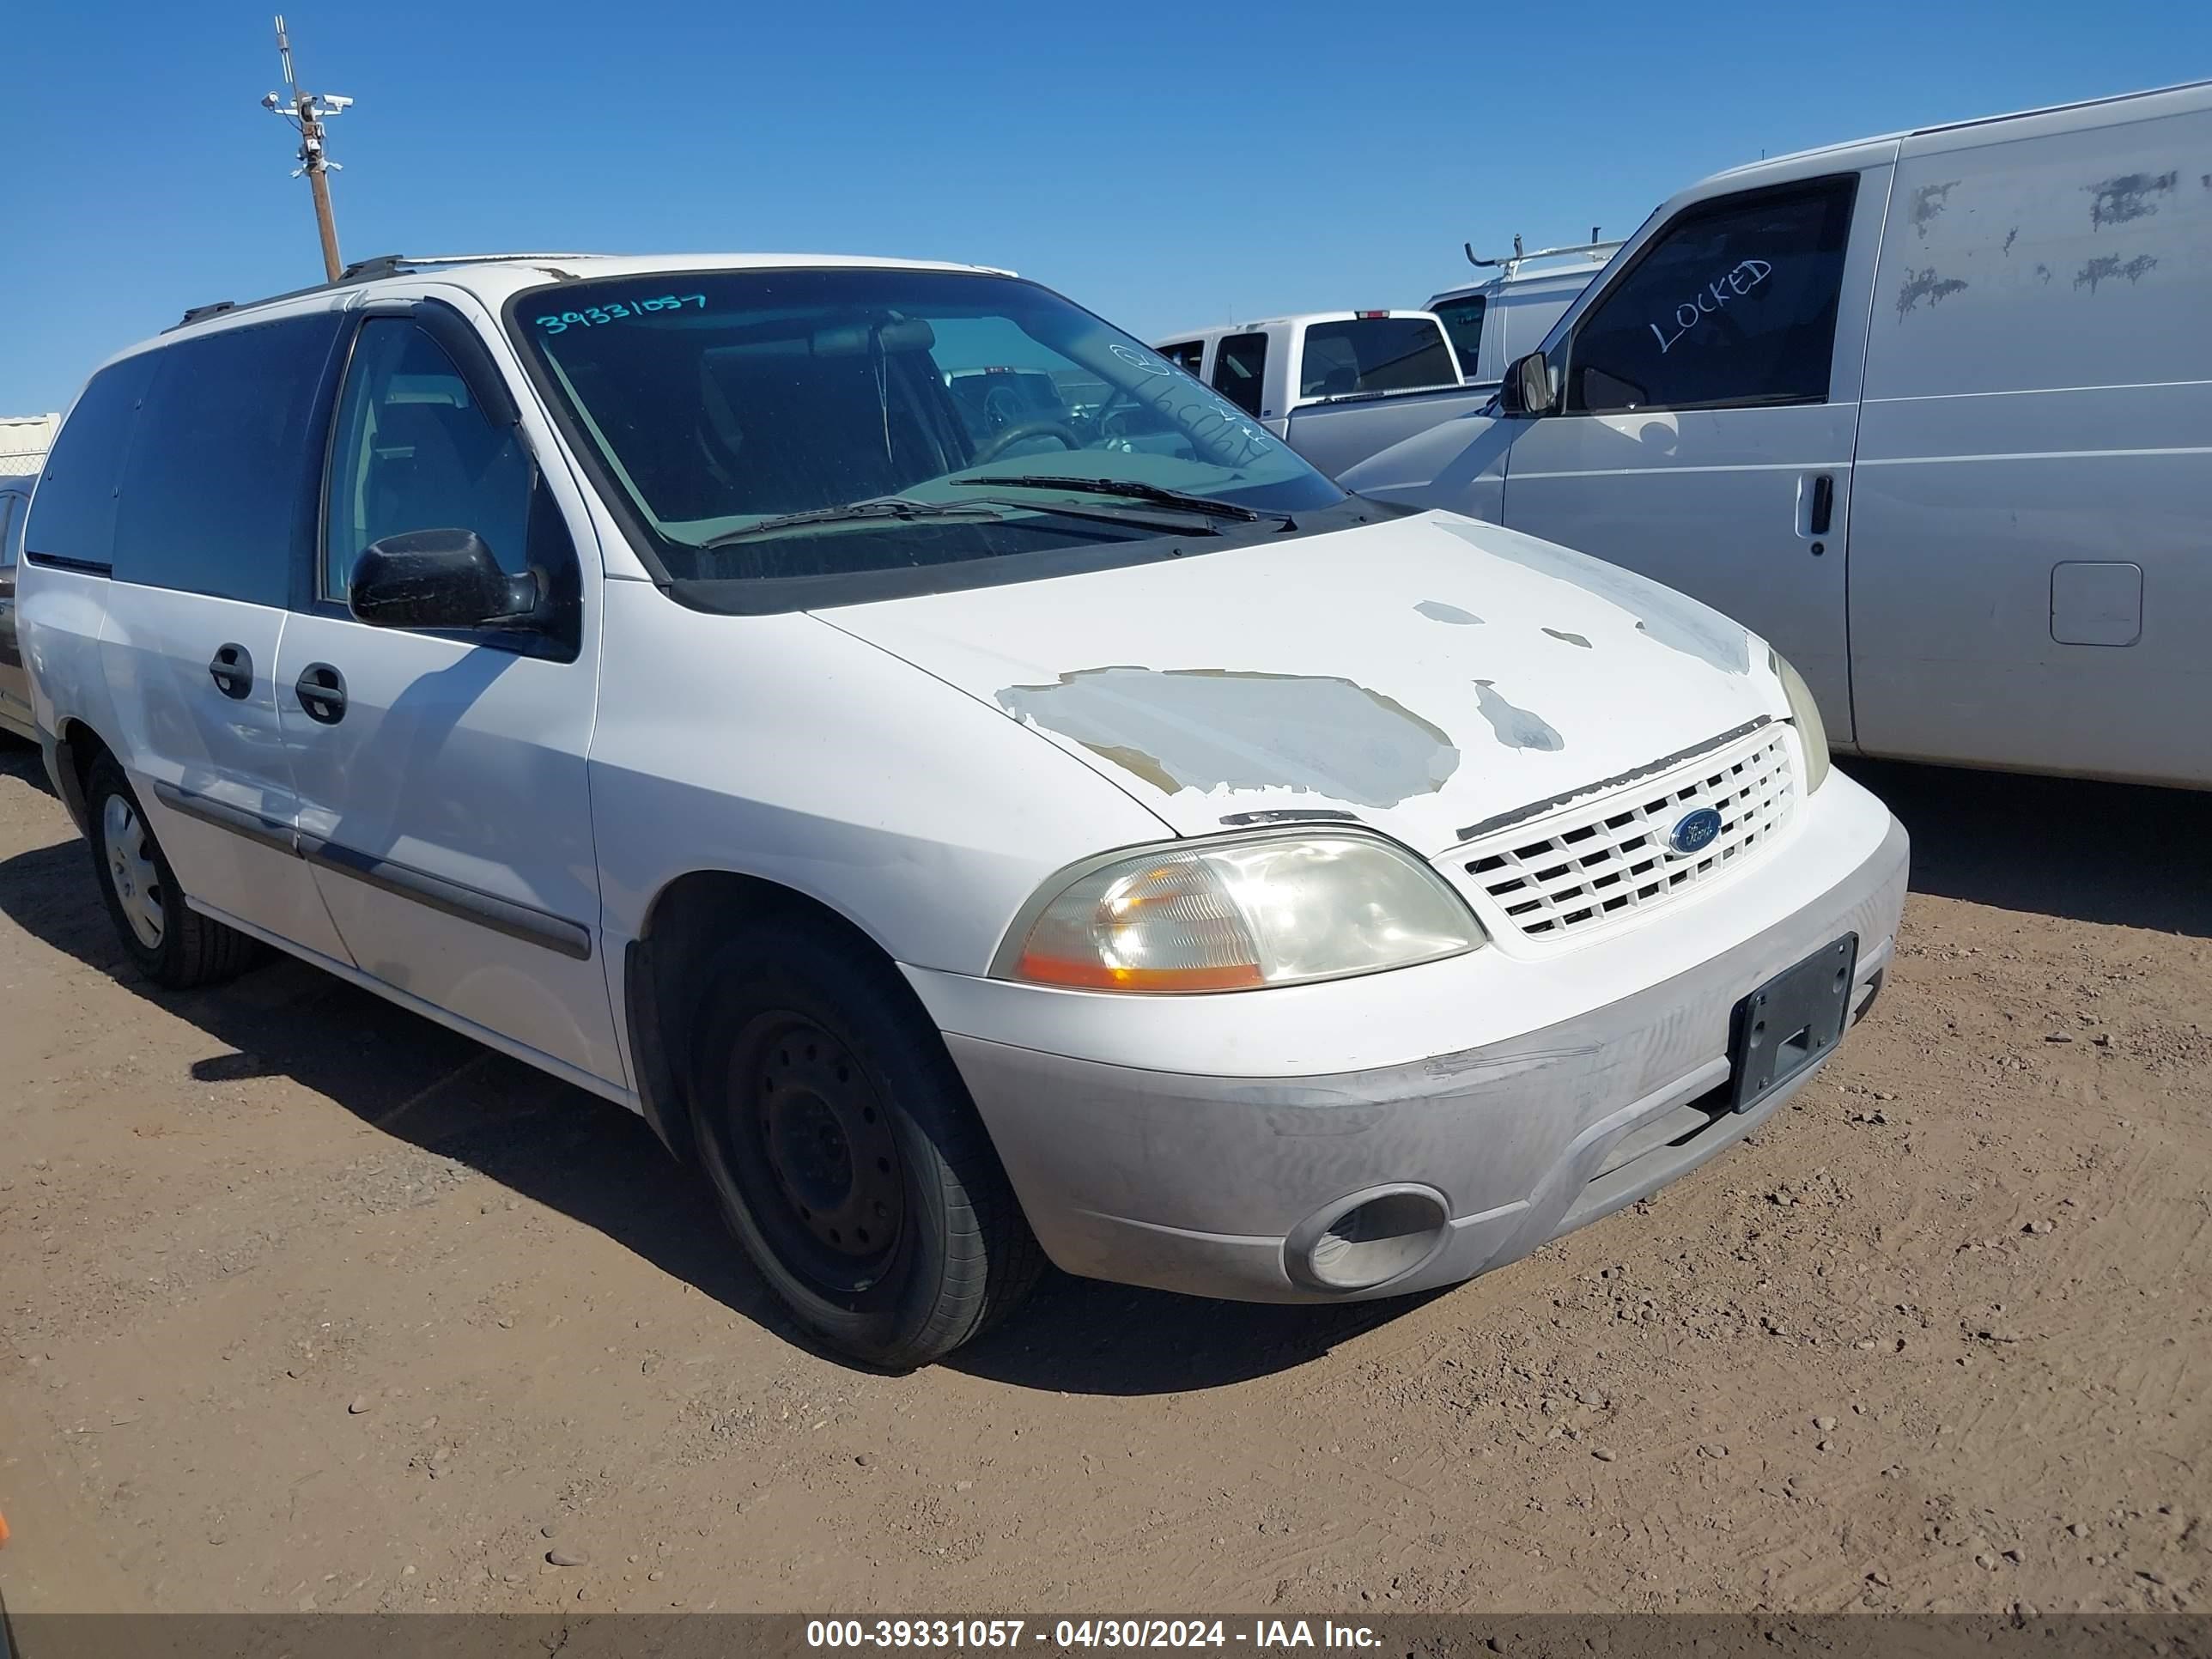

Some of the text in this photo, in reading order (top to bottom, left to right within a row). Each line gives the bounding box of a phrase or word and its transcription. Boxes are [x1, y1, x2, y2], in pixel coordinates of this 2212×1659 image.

[536, 294, 706, 335] 39331057
[1649, 259, 1772, 355] LOCKED
[1685, 819, 1714, 847] Ford
